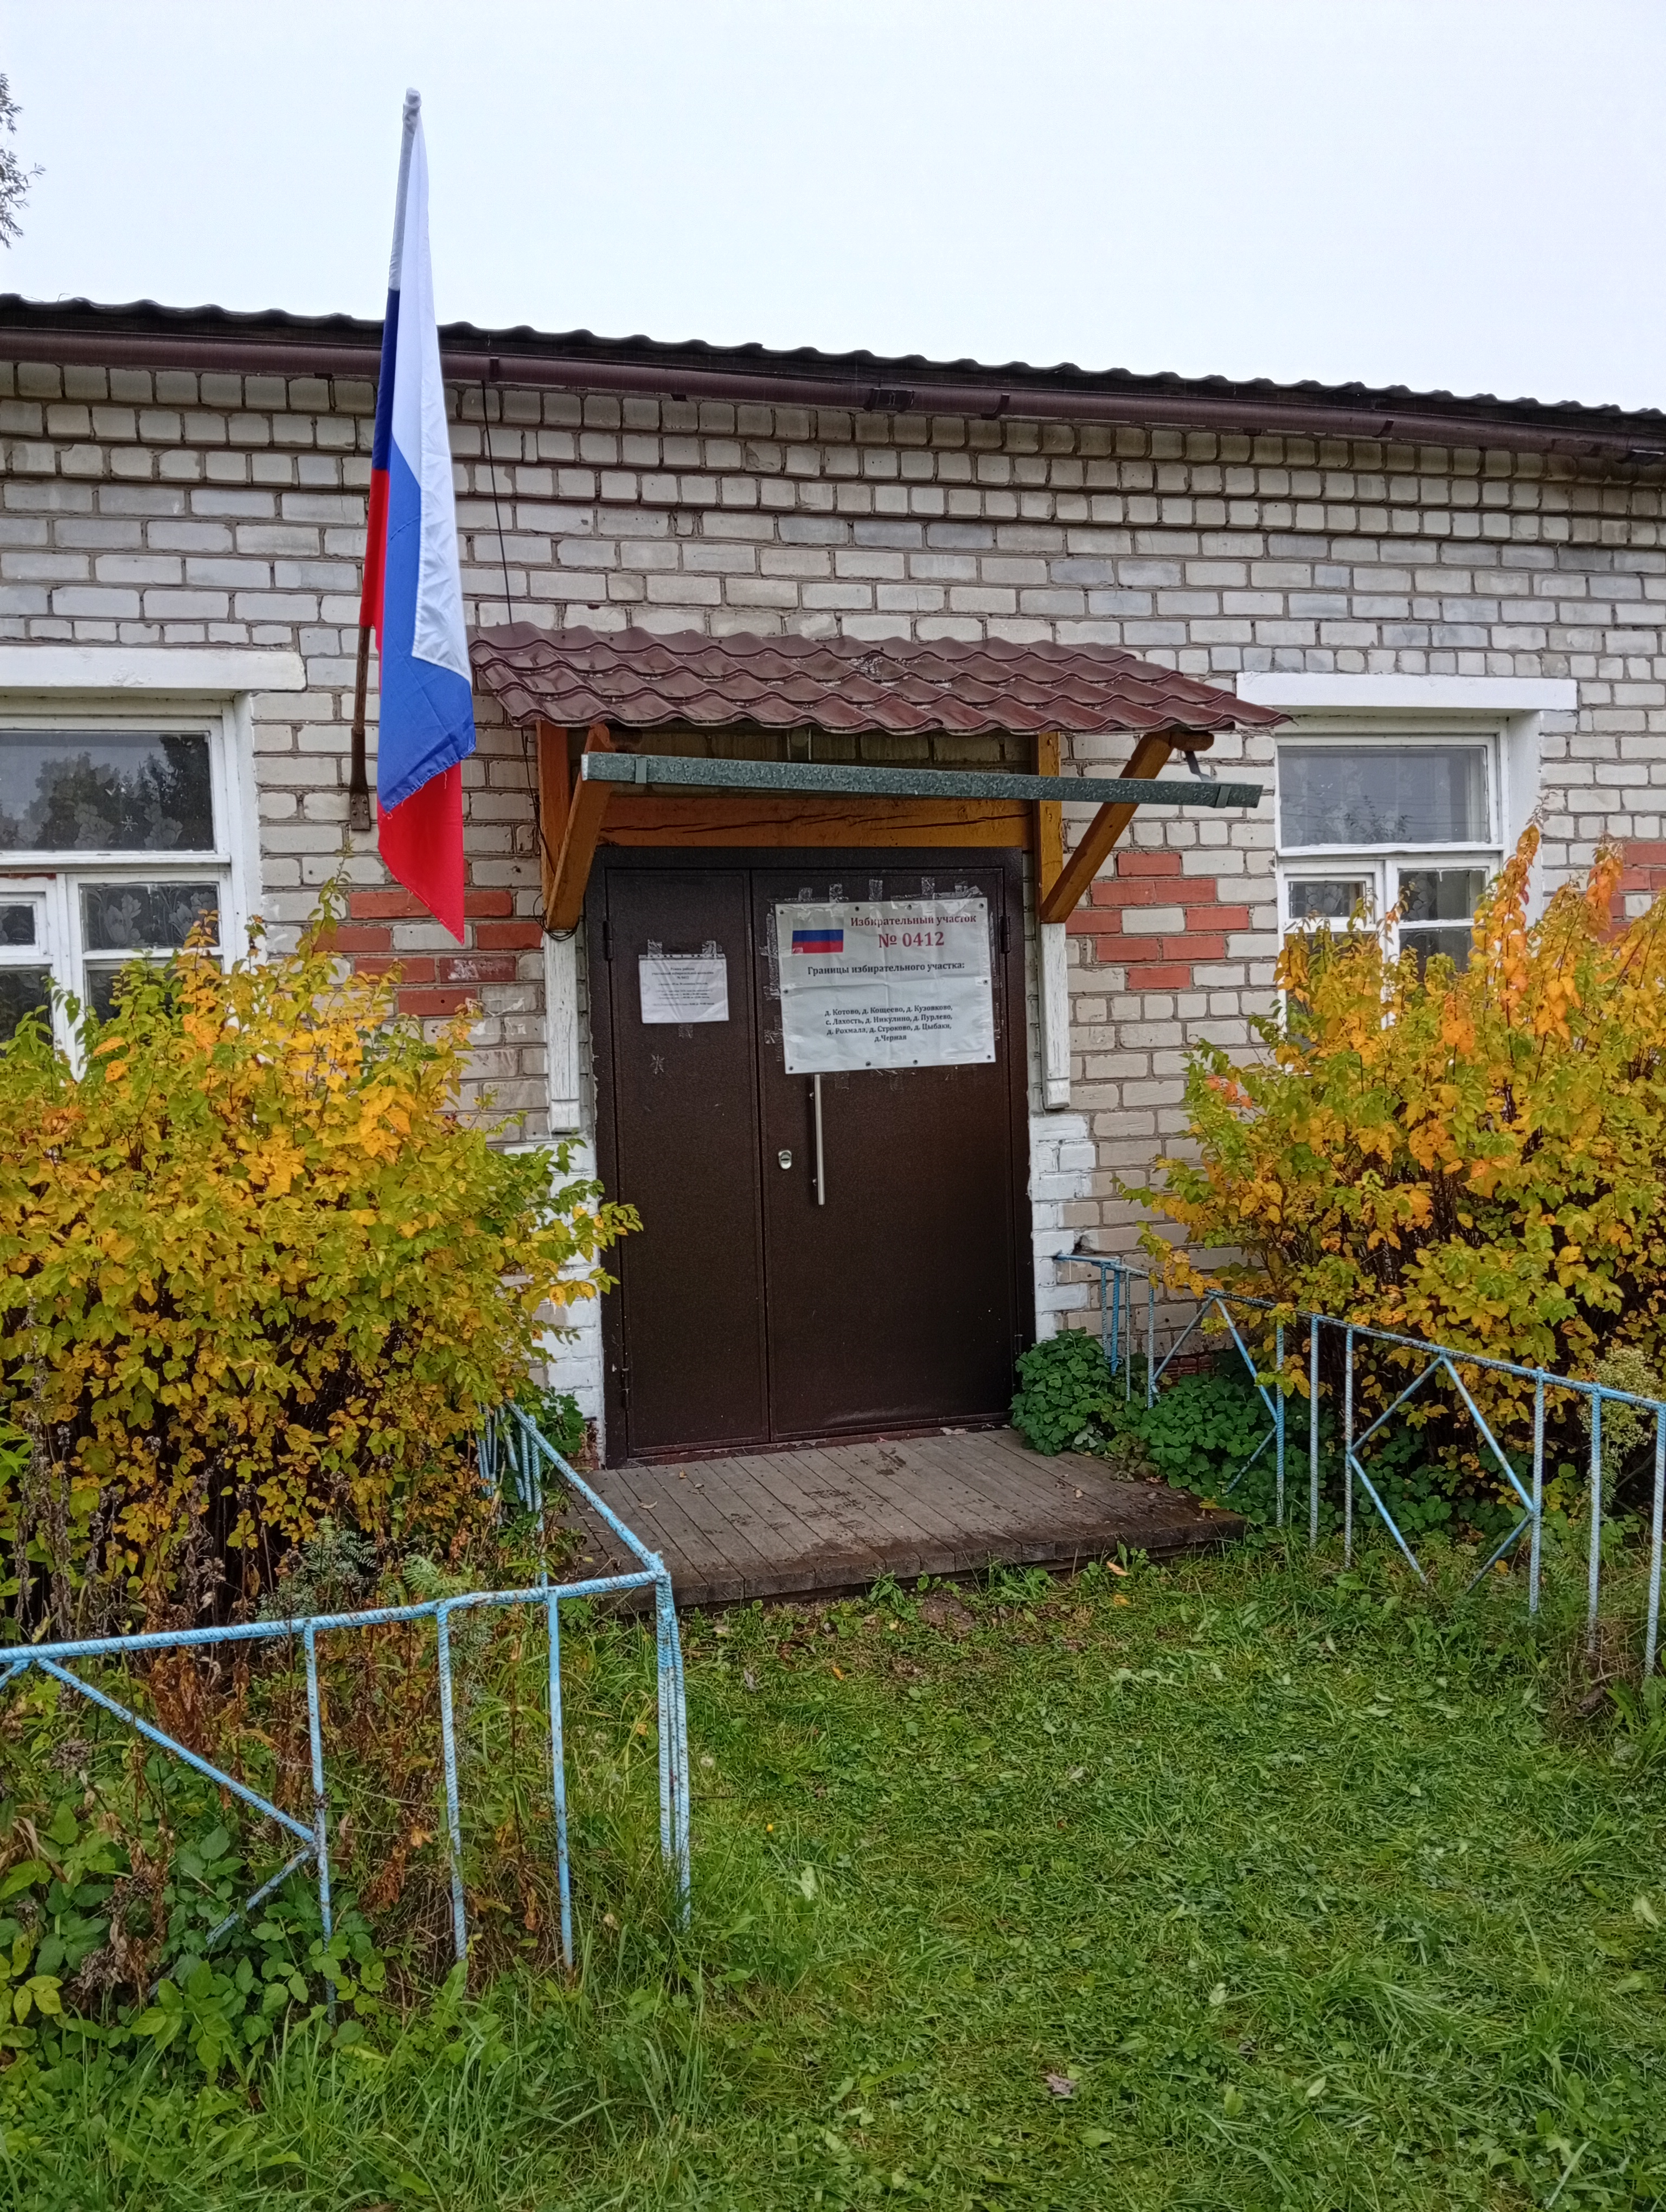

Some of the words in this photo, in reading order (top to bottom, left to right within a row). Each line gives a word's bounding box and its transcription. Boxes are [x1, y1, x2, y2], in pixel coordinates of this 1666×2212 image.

[851, 916, 934, 928] Избирательный
[936, 915, 977, 926] участок
[878, 934, 898, 948] №
[902, 931, 945, 947] 0412
[808, 967, 849, 976] Границы
[851, 963, 925, 974] избирательного
[927, 962, 965, 973] участка:
[873, 1015, 912, 1024] Никулино,
[921, 1014, 953, 1022] Пурлево,
[877, 1025, 913, 1033] Строково,
